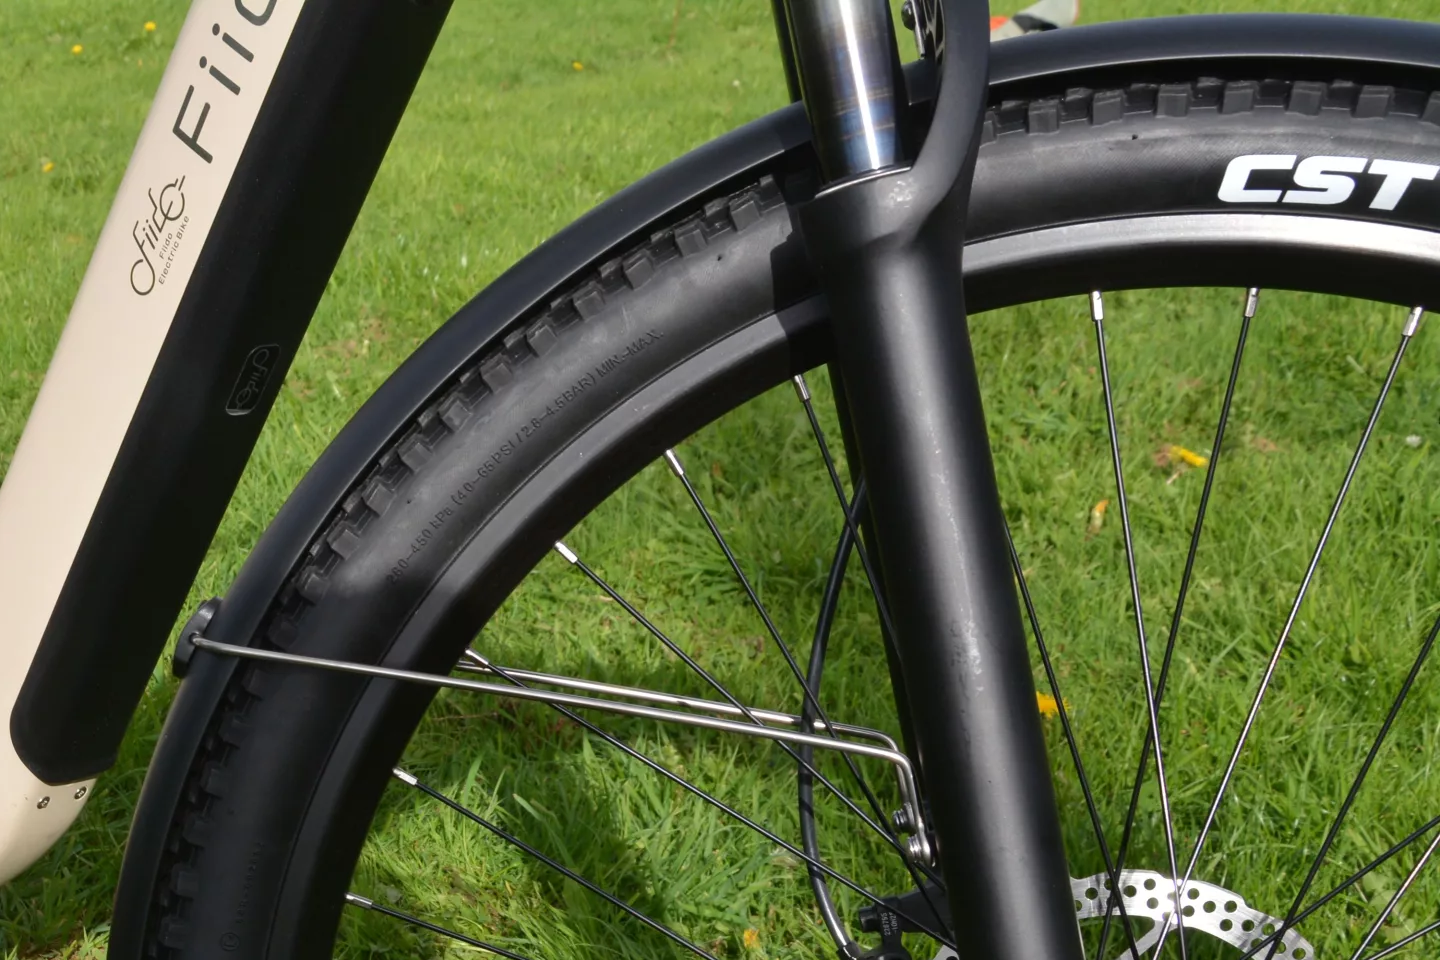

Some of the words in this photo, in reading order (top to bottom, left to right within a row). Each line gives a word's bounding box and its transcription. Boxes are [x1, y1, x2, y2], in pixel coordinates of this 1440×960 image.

[1217, 154, 1440, 211] CST
[158, 232, 173, 260] Fiido
[158, 241, 179, 285] Electric
[176, 215, 190, 240] Bike
